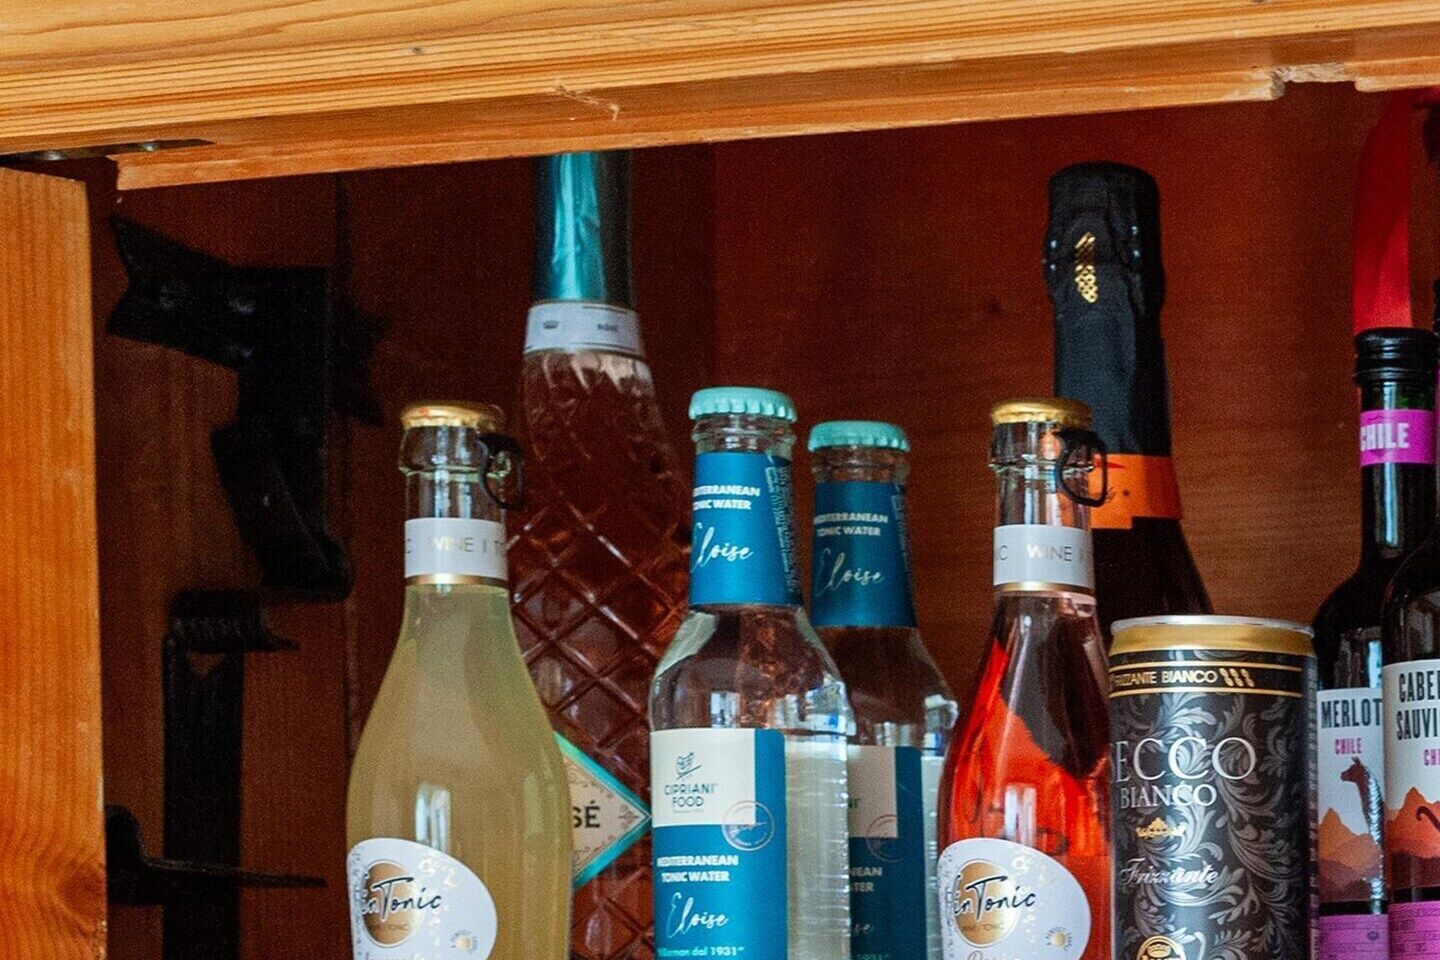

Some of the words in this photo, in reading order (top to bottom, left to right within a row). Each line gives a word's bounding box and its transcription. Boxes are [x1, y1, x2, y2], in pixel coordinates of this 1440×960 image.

[712, 499, 752, 510] WATER
[1161, 669, 1218, 684] BIANCO
[1335, 737, 1362, 754] CHILE
[1115, 736, 1257, 783] ECCO
[672, 796, 704, 807] FOOD
[1121, 783, 1217, 809] BIANCO
[687, 870, 731, 882] WATER
